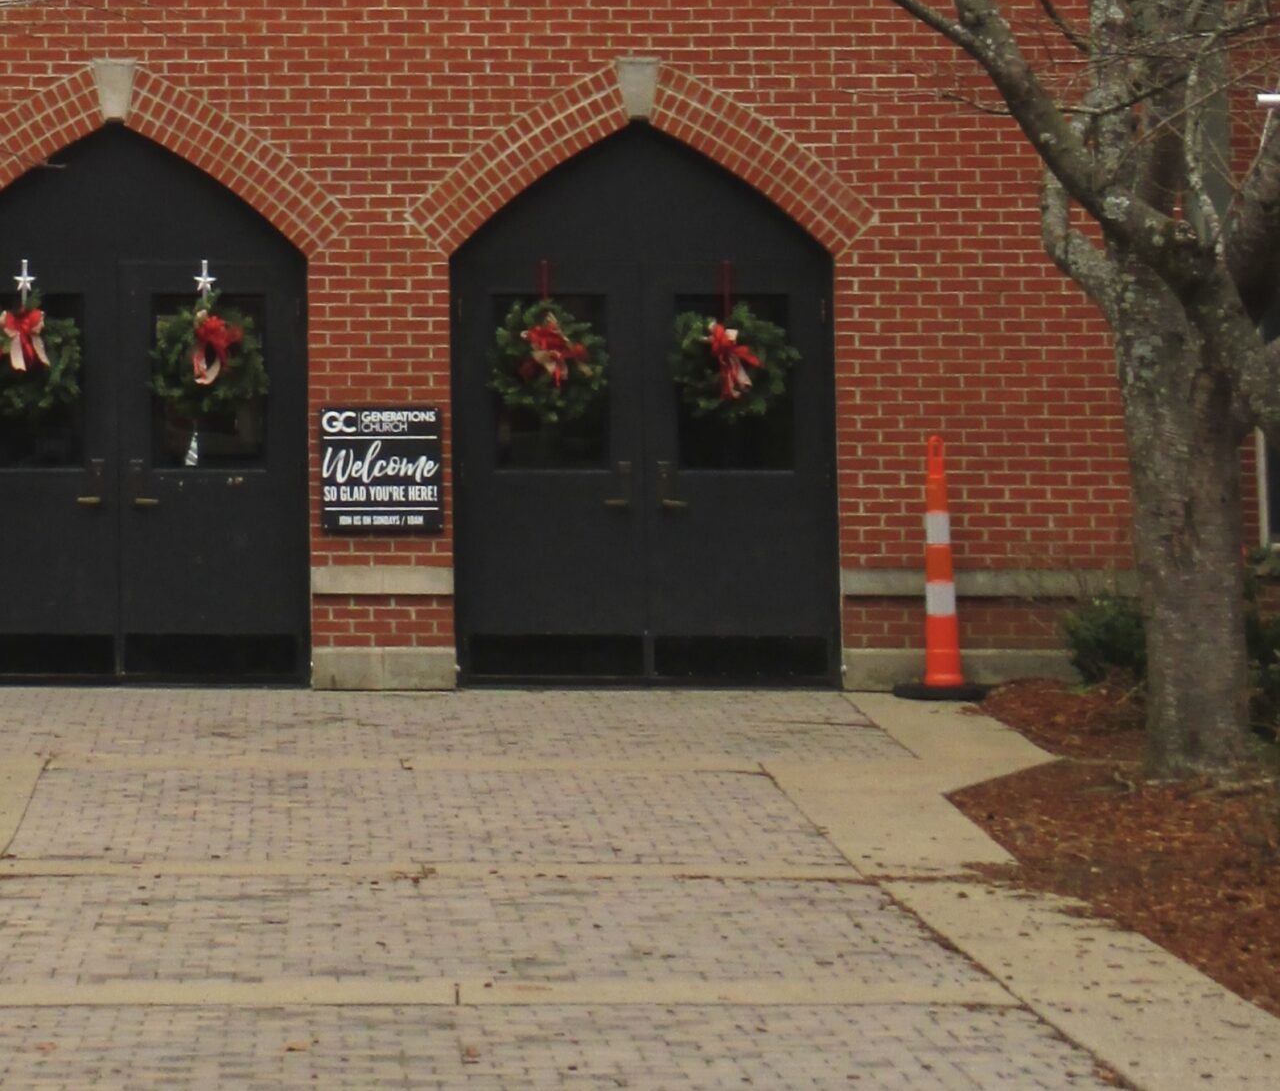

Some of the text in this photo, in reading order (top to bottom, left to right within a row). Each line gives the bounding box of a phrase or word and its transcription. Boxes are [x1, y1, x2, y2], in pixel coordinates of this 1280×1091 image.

[322, 411, 357, 433] GC
[361, 411, 436, 422] GENERATIONS
[361, 422, 408, 433] CHURCH
[322, 440, 439, 483] Welcome
[323, 485, 438, 501] SO GLAD YOU'RE HERE!
